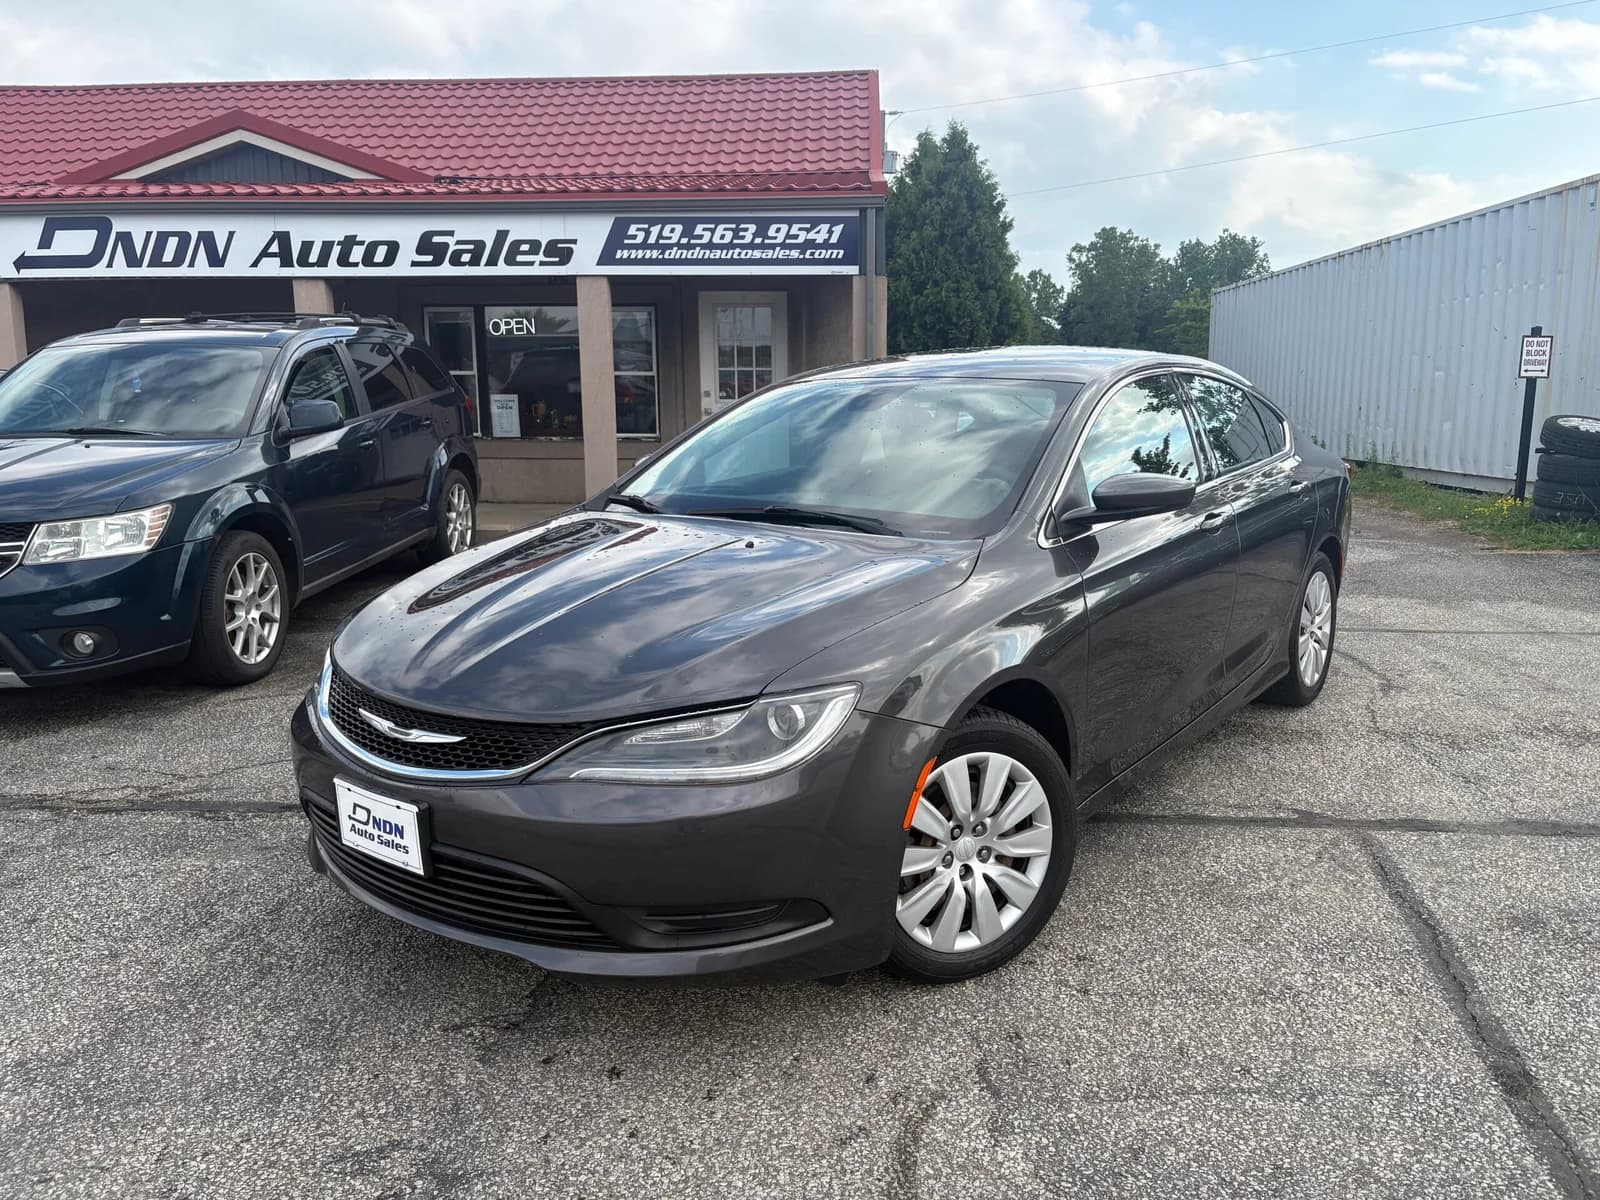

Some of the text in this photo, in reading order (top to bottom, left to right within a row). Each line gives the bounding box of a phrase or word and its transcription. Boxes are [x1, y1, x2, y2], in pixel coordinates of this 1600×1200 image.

[623, 223, 845, 244] 519.563.9541
[13, 215, 578, 275] DNDN Auto Sales
[615, 246, 845, 260] www.dndnautosales.com
[489, 318, 536, 336] OPEN
[1525, 349, 1547, 357] BLOCK
[347, 802, 405, 840] DNDN
[349, 823, 410, 855] Auto Sales
